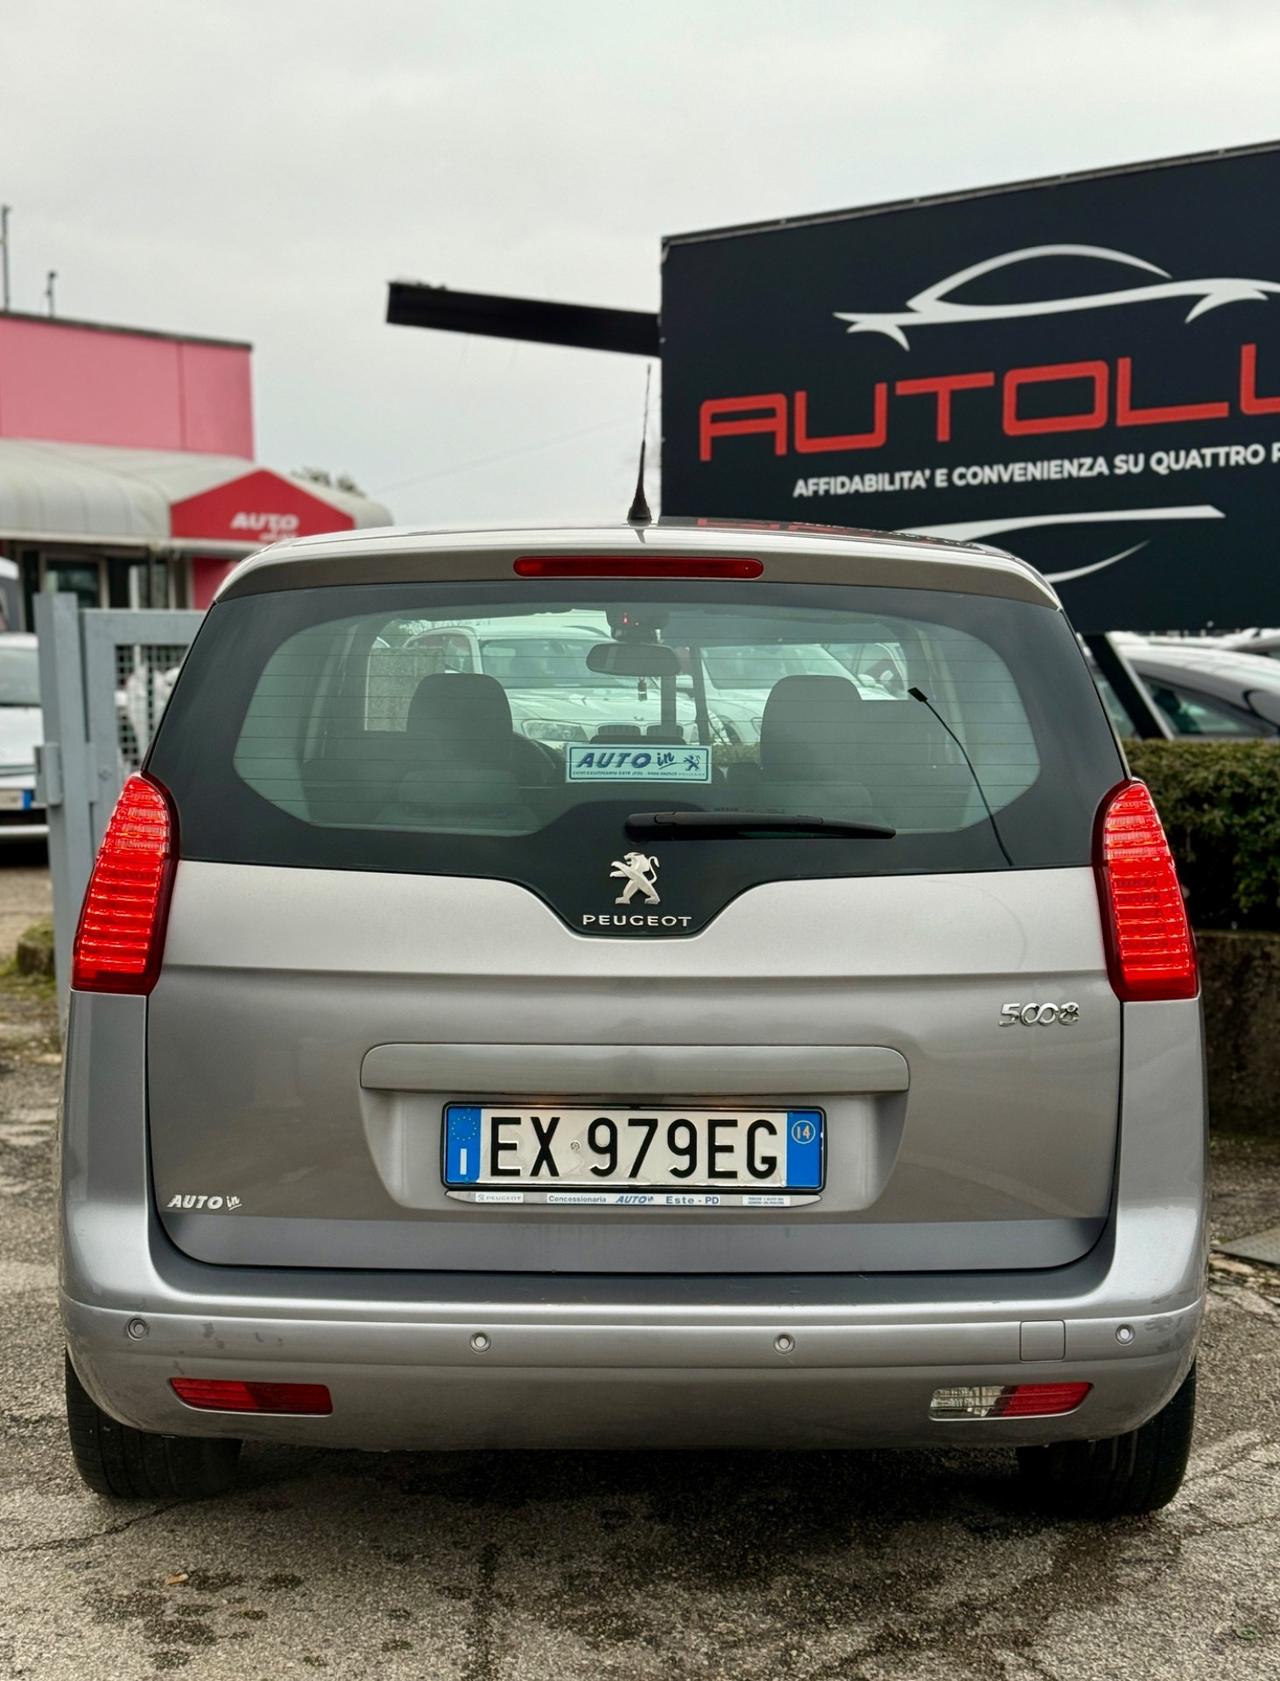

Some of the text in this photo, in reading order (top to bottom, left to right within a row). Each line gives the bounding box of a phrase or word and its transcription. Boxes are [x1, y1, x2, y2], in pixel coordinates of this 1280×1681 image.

[935, 468, 948, 486] E
[953, 456, 1109, 486] CONVENIENZA
[1113, 453, 1146, 475] SU
[1150, 443, 1266, 472] QUATTRO
[229, 512, 299, 530] AUTO
[575, 752, 676, 768] AUTO in
[582, 914, 692, 927] PEUGEOT
[999, 1002, 1080, 1026] 5008
[490, 1116, 778, 1180] EX 979EG
[166, 1194, 241, 1210] AUTO in
[548, 1195, 607, 1204] Concessionaria
[616, 1195, 647, 1204] AUTO
[665, 1195, 695, 1204] Este
[705, 1195, 719, 1205] PD
